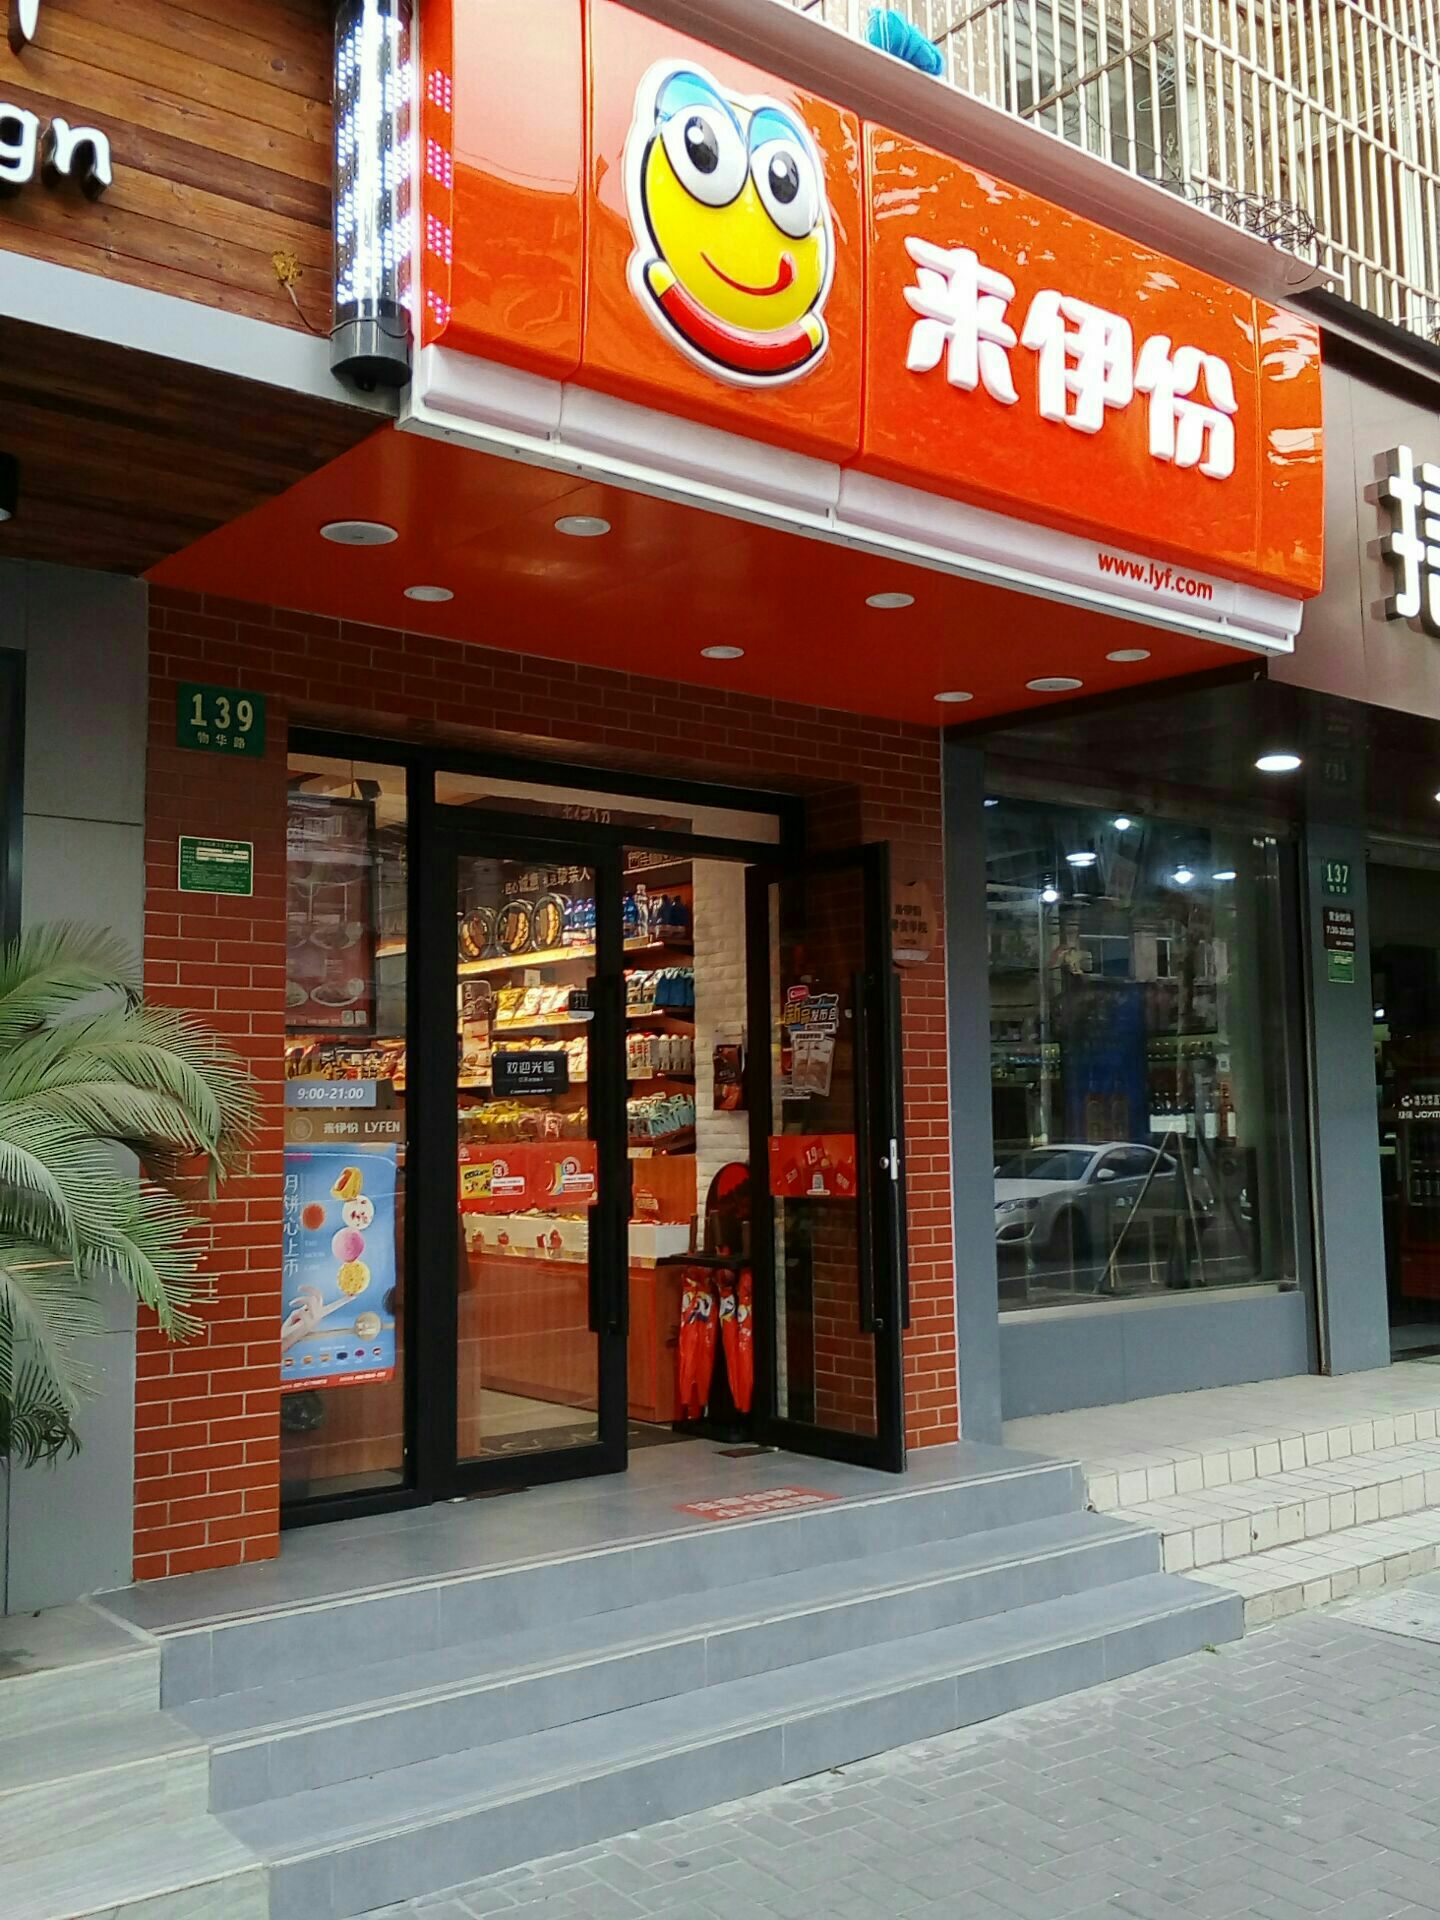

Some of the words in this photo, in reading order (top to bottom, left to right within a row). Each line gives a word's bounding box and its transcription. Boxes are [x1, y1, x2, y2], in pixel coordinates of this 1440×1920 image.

[904, 235, 1239, 481] 来伊份
[1098, 552, 1213, 601] www.lyf.com
[190, 693, 254, 733] 139
[1326, 863, 1349, 884] 137
[506, 1060, 556, 1074] 欢迎光临
[297, 1087, 365, 1100] 9:00-21:00
[364, 1120, 401, 1133] LYFEN
[283, 1173, 300, 1278] 月饼心上市
